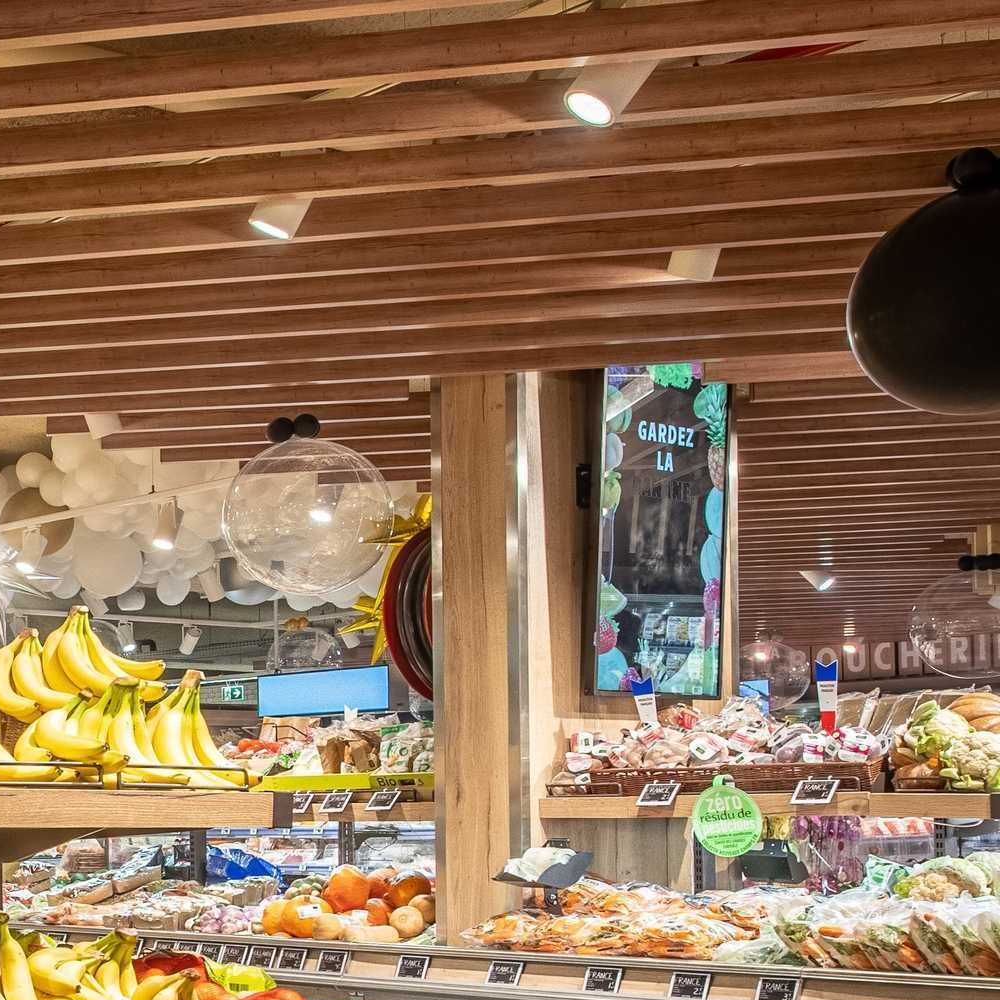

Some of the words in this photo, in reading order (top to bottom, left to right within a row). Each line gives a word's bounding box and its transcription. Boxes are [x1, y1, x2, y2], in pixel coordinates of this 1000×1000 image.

[637, 420, 694, 448] GARDEZ
[656, 451, 674, 473] LA
[700, 809, 735, 823] résidu
[737, 808, 752, 819] de
